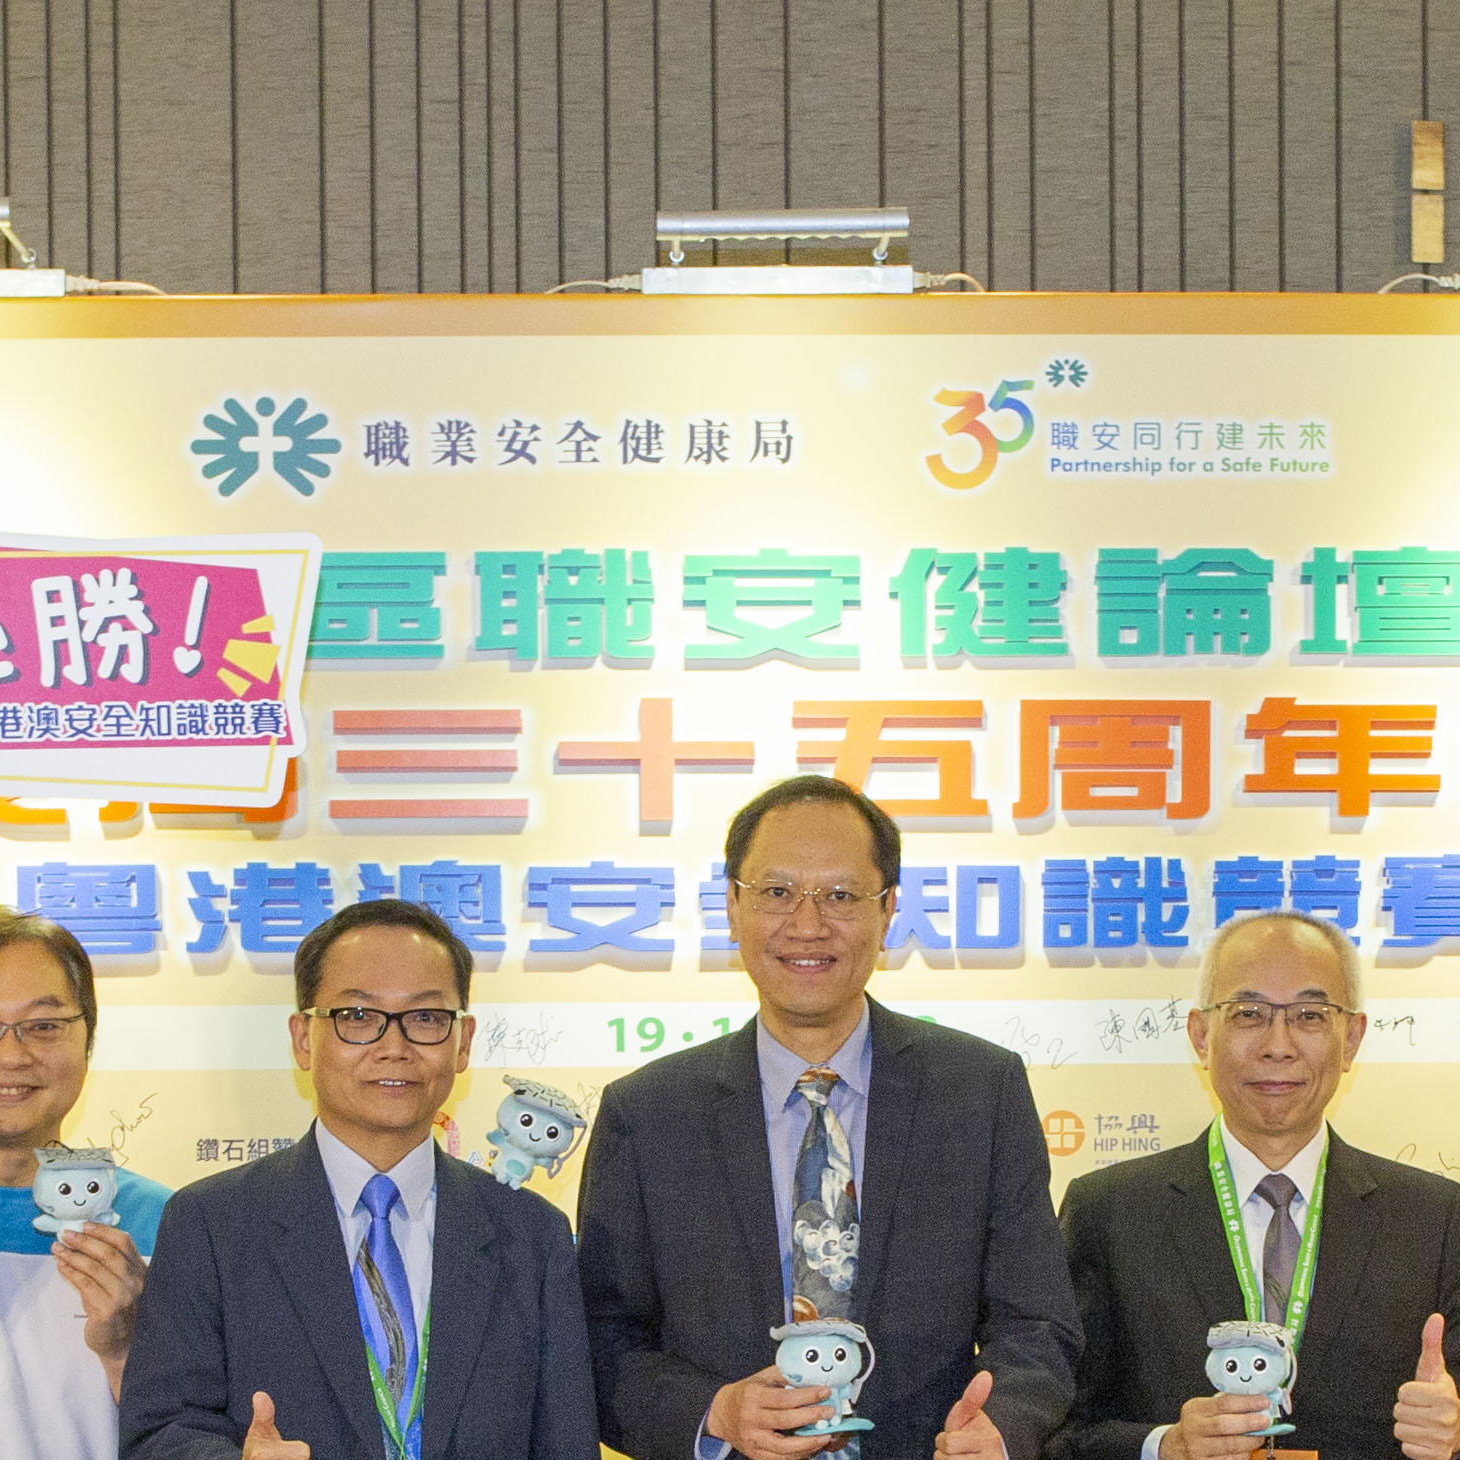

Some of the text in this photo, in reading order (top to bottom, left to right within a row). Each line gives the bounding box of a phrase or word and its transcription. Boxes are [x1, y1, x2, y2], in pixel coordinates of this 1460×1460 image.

[362, 418, 794, 468] 職業安全健康局
[925, 378, 1035, 490] 35
[1050, 421, 1328, 451] 職安同行建未來
[1050, 457, 1330, 476] Partnership for a Safe Future
[1094, 1137, 1161, 1152] HIP HING
